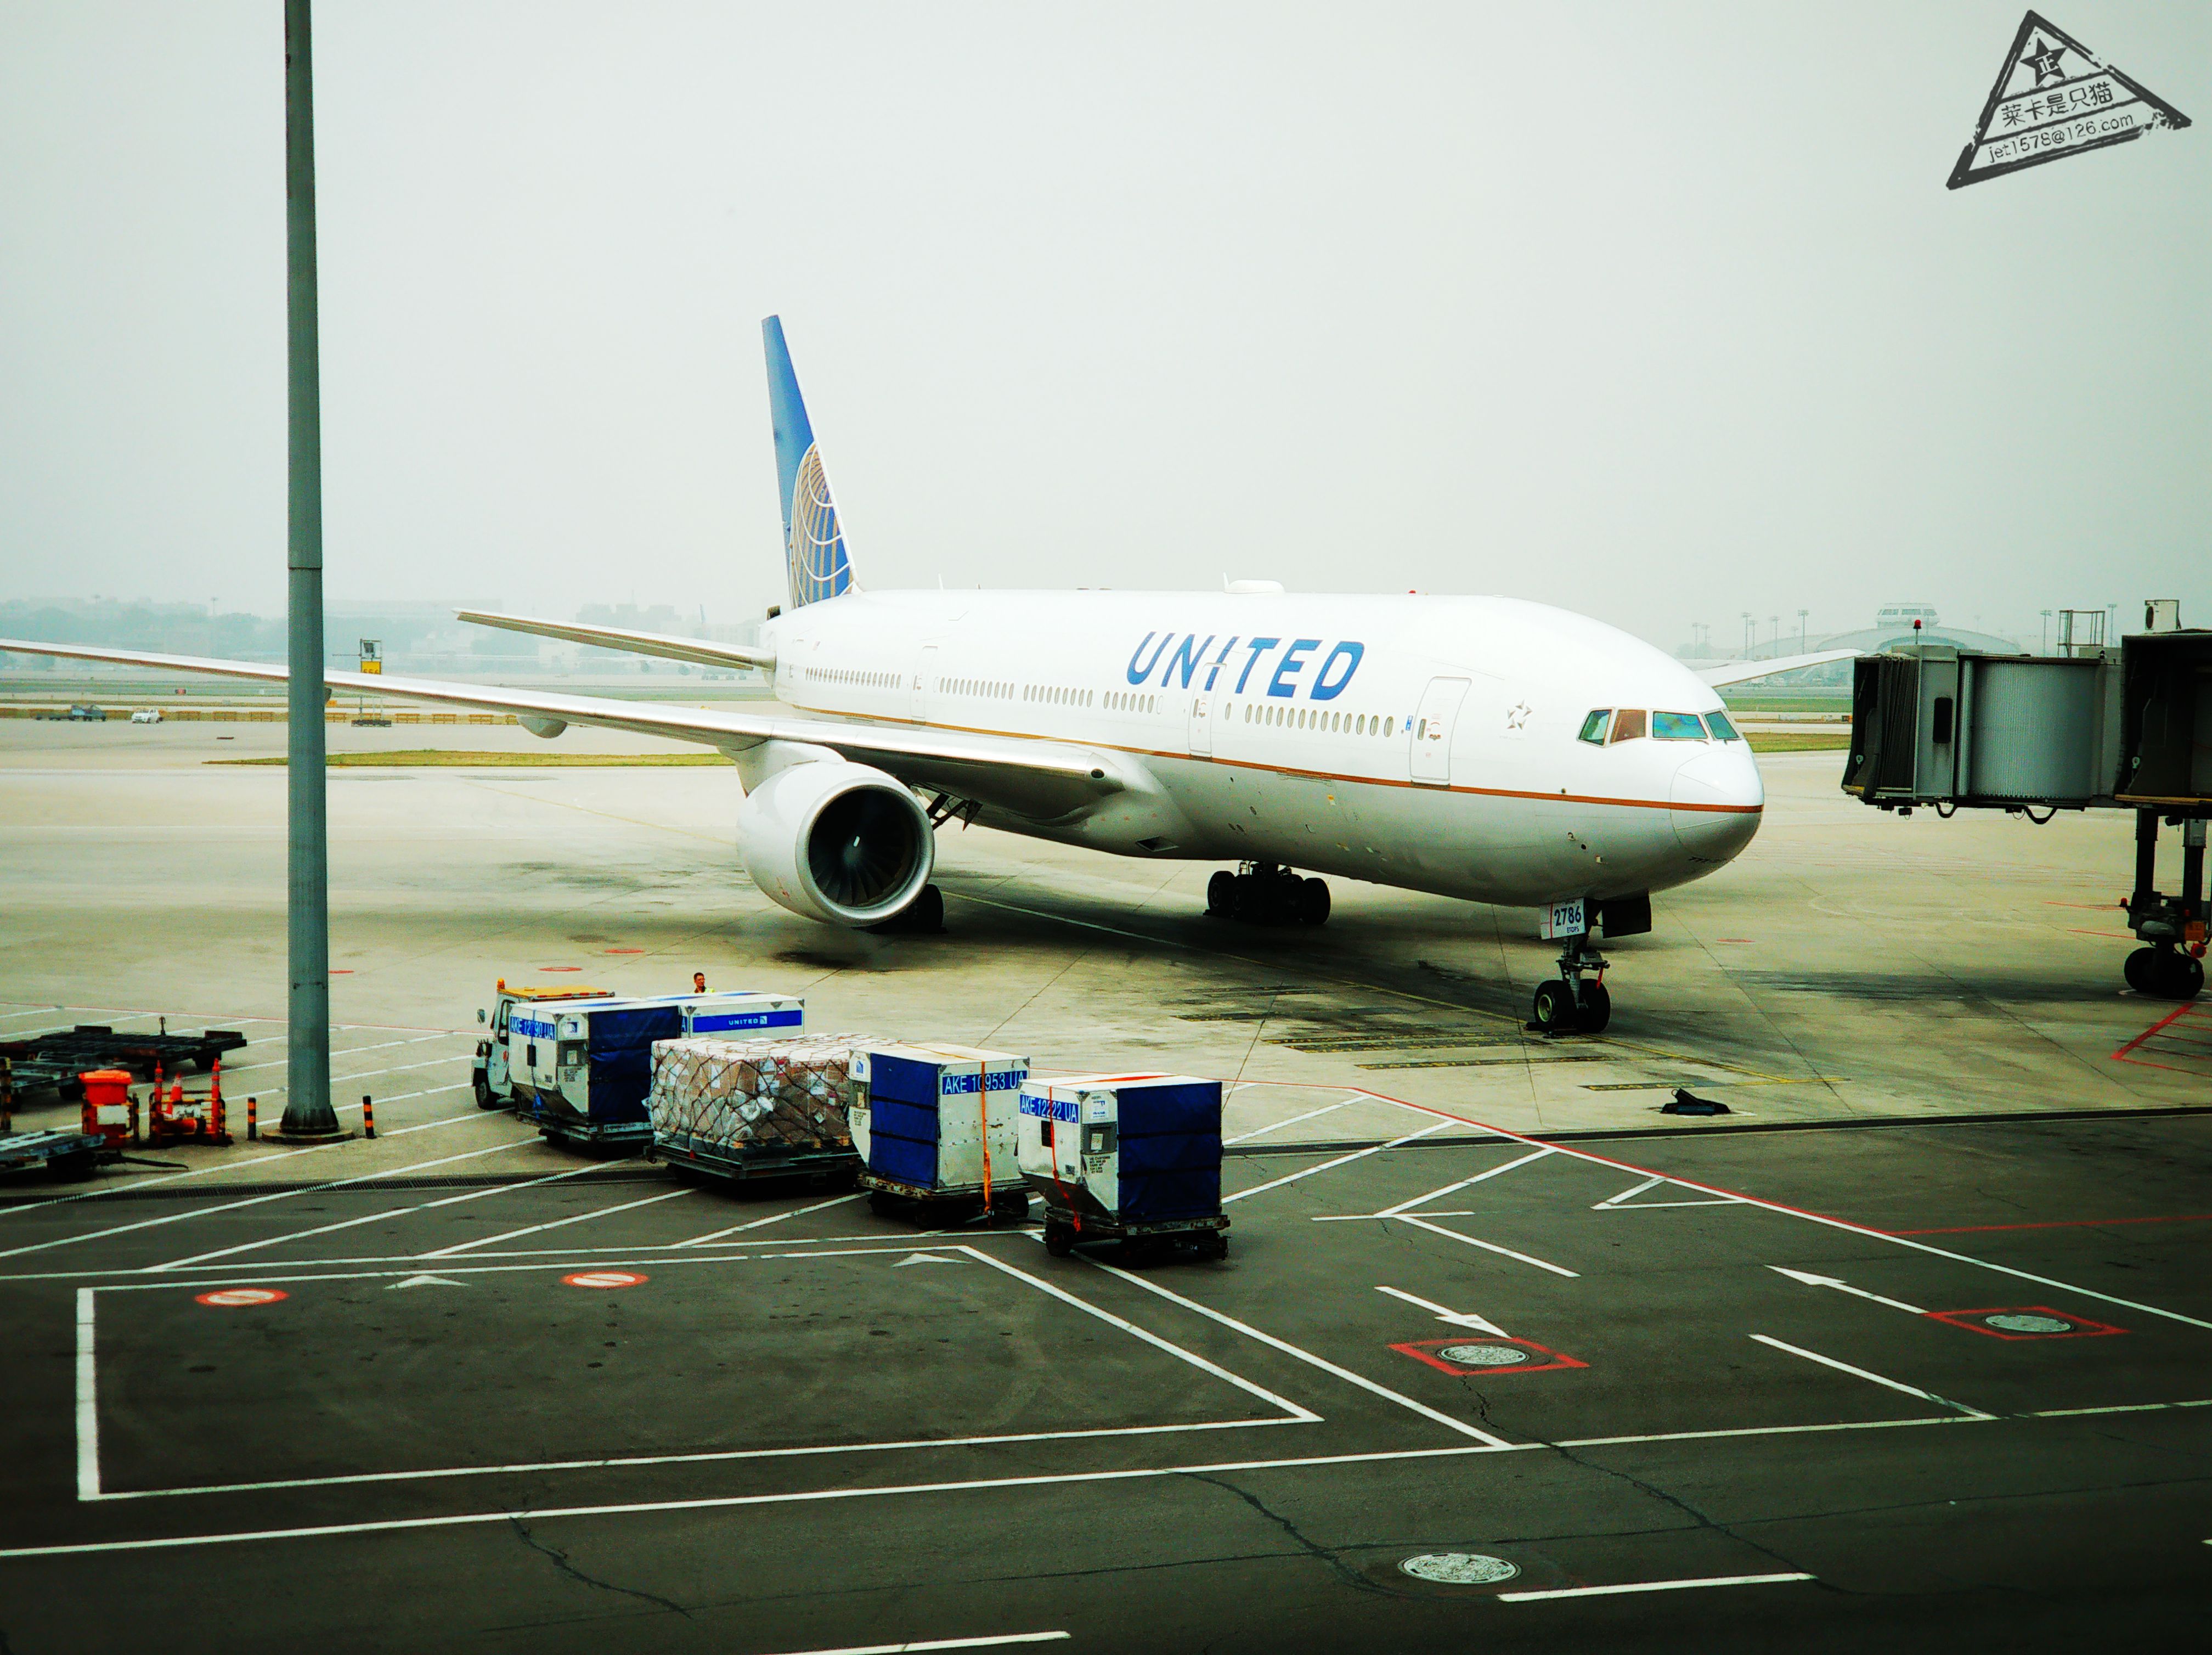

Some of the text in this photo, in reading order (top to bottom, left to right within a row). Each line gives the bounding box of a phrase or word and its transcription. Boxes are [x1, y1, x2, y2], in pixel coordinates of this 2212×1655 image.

[1127, 631, 1365, 701] UNITED
[1554, 905, 1582, 926] 2786
[511, 1017, 522, 1033] AKE
[544, 1023, 554, 1040] UA
[944, 1076, 967, 1094] AKE
[1021, 1095, 1036, 1115] AKE
[1065, 1103, 1077, 1123] UA
